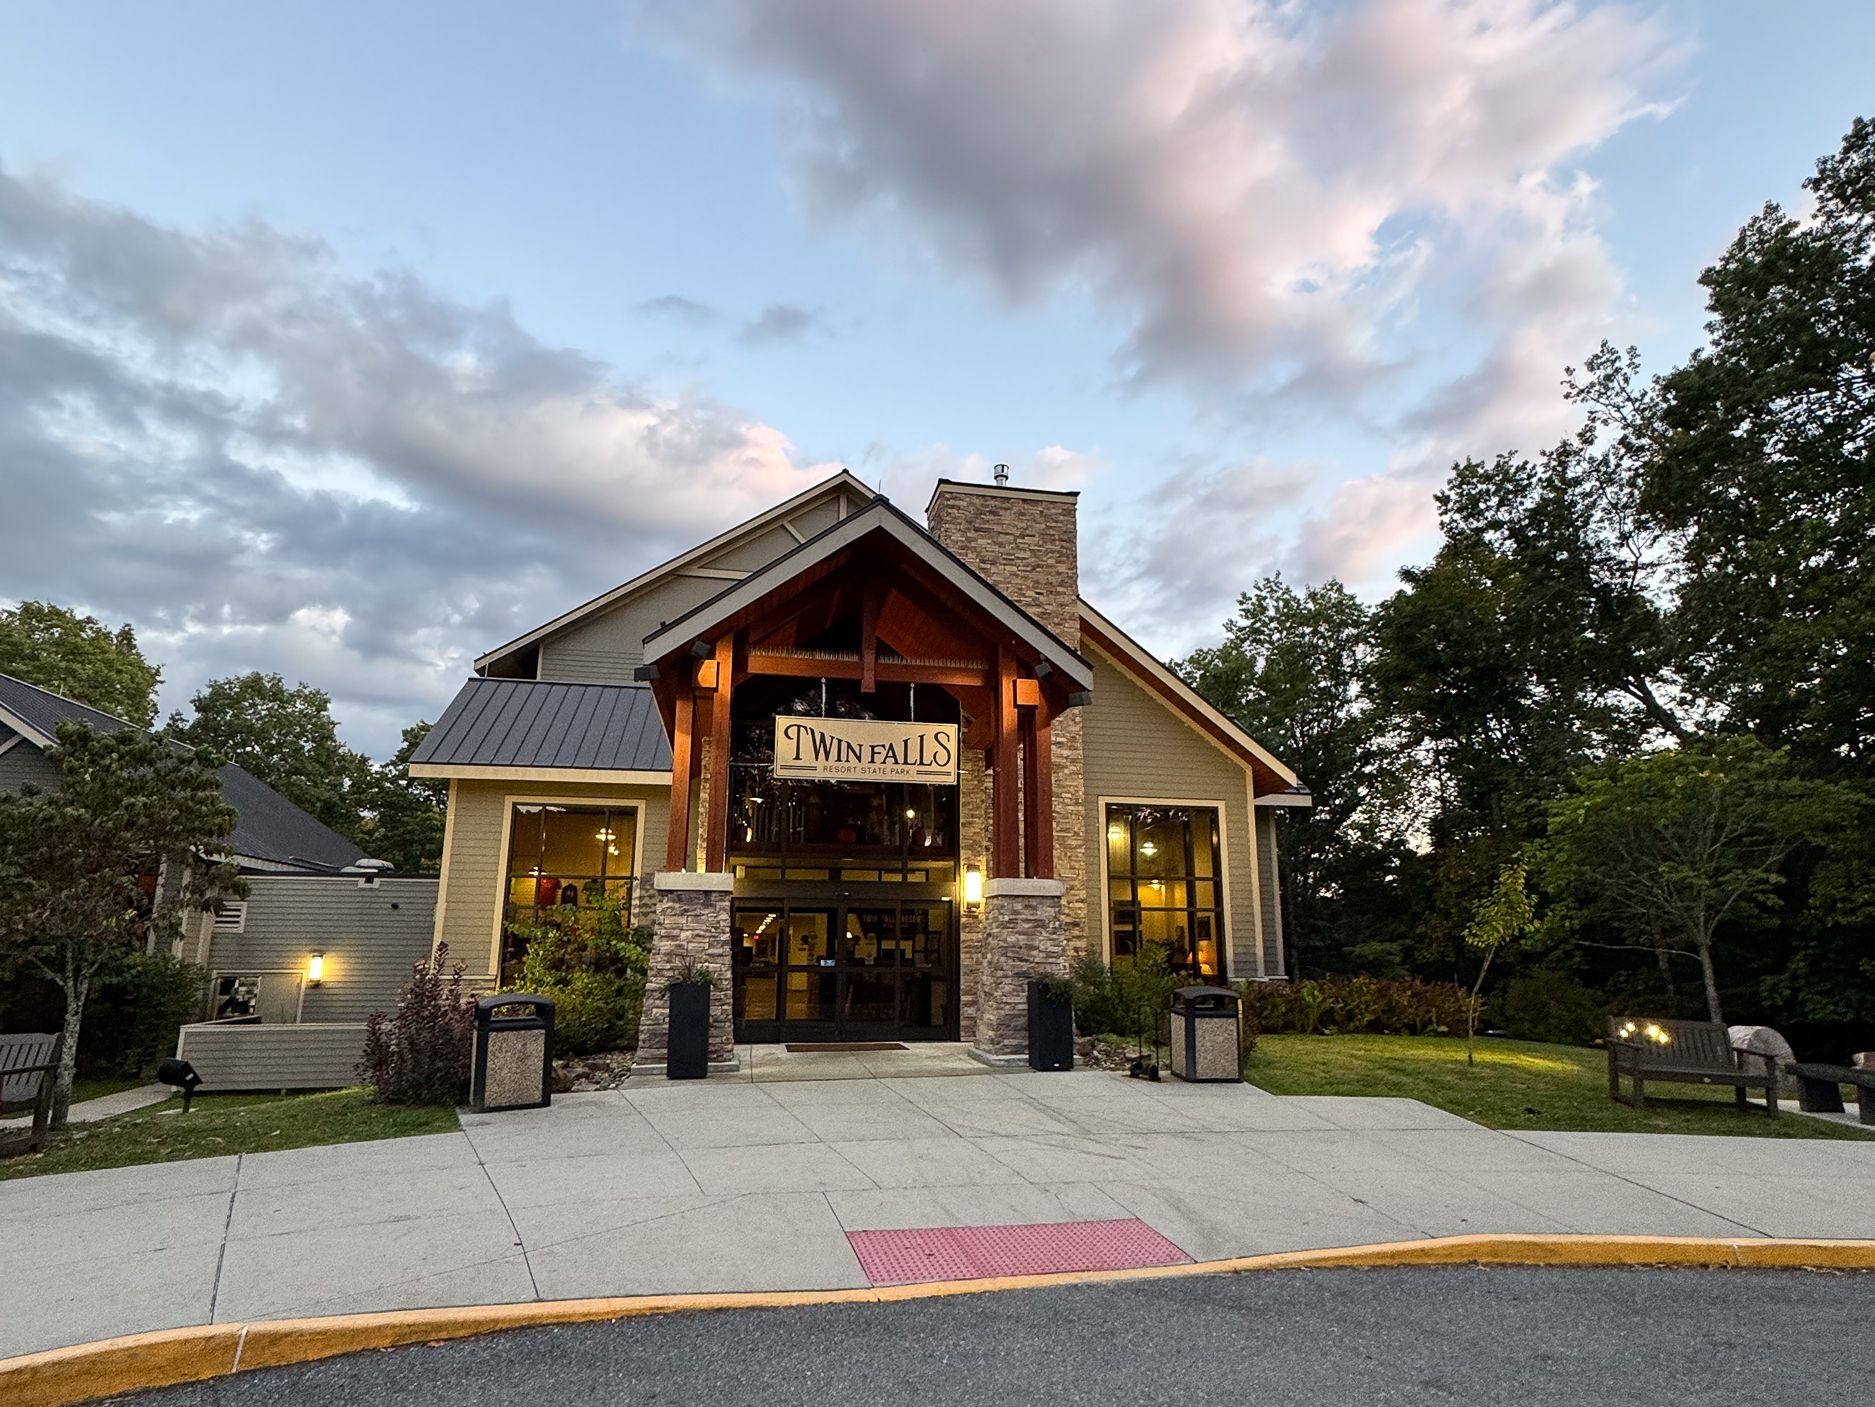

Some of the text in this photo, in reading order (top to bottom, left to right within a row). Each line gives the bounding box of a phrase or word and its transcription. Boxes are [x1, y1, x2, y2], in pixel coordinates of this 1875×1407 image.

[784, 724, 951, 767] TWIN FALLS
[823, 765, 911, 776] RESORT STATE PARK
